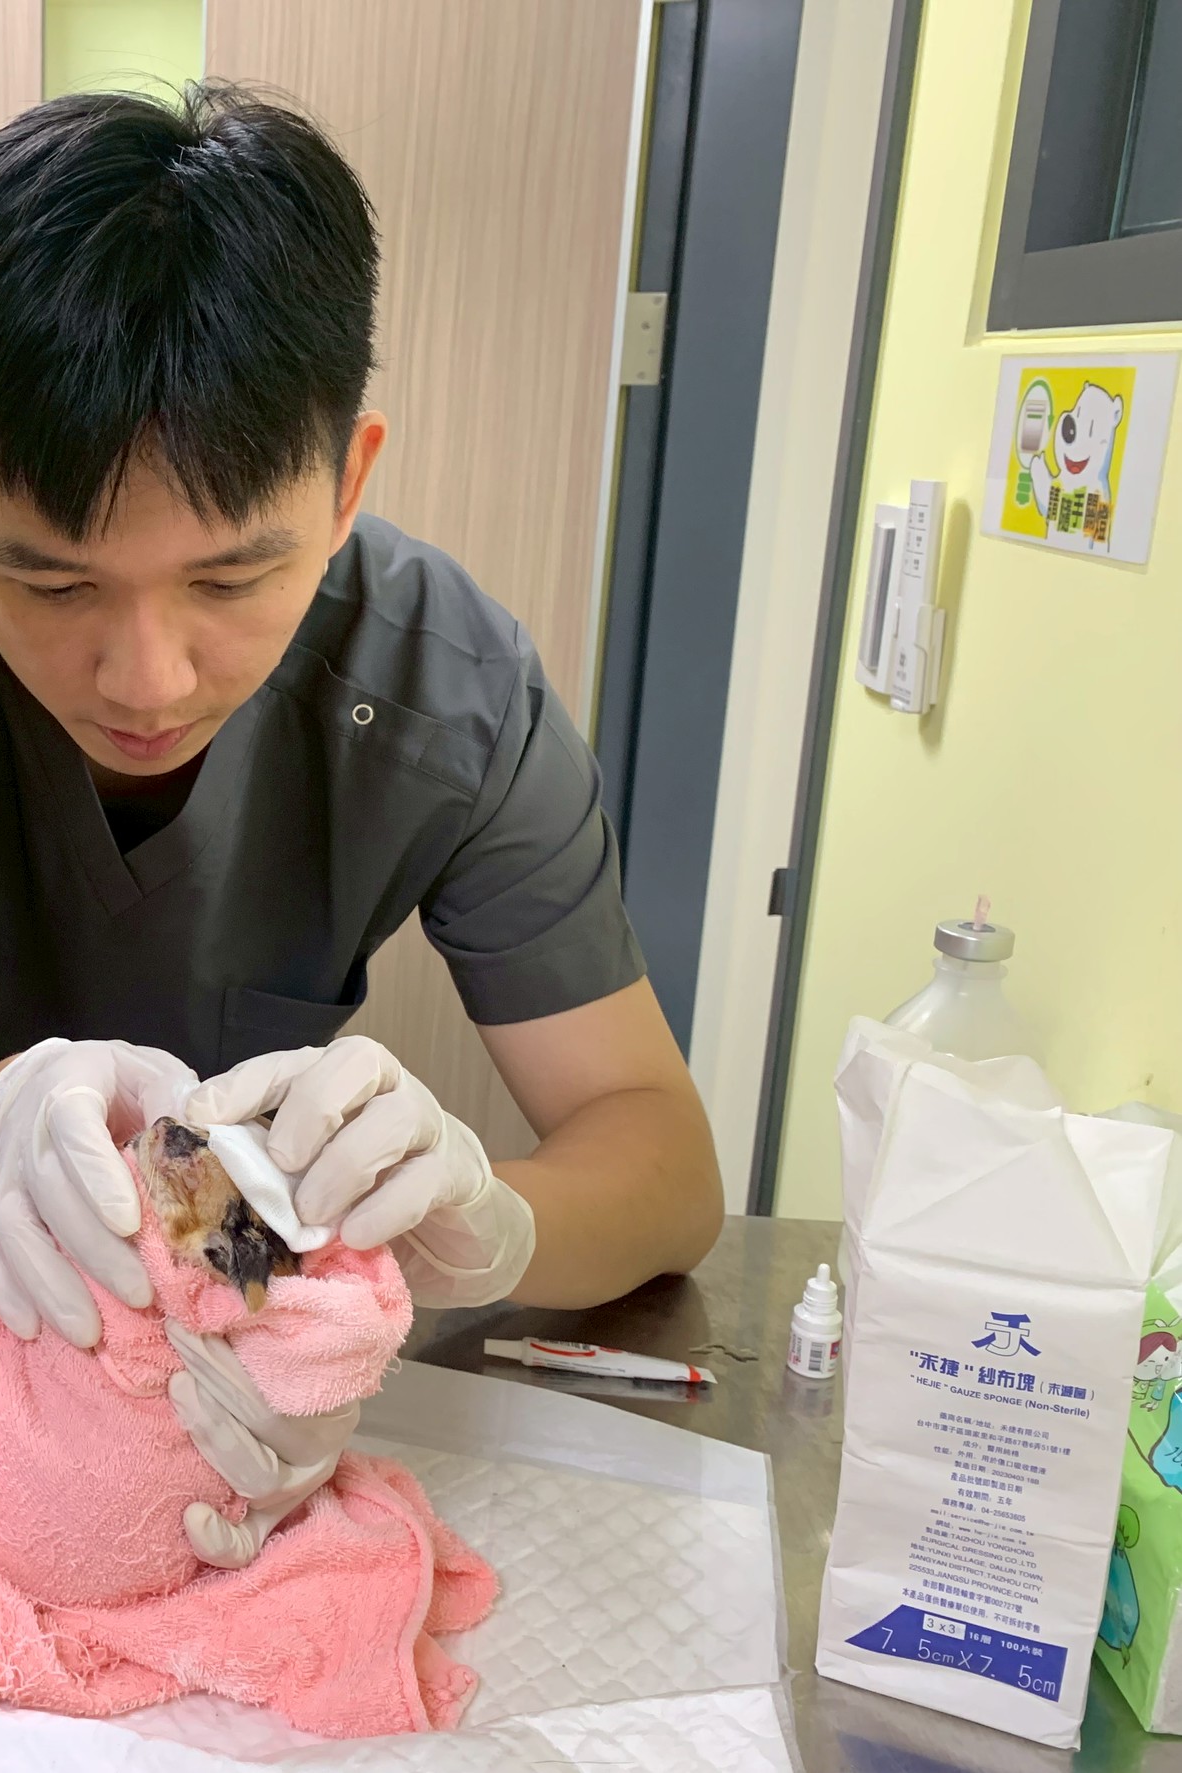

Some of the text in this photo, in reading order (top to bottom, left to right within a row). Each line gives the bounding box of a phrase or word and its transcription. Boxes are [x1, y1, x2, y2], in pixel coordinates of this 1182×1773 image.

[949, 1385, 982, 1399] GAUZE
[983, 1393, 1023, 1406] SPONGE
[1024, 1399, 1090, 1419] (Non-Sterile)
[920, 1535, 960, 1551] SURGICAL
[961, 1546, 1003, 1561] DRESSING
[986, 1540, 1035, 1558] YONGHONG
[909, 1552, 948, 1567] JIANGYAN
[989, 1563, 1016, 1575] DALUN
